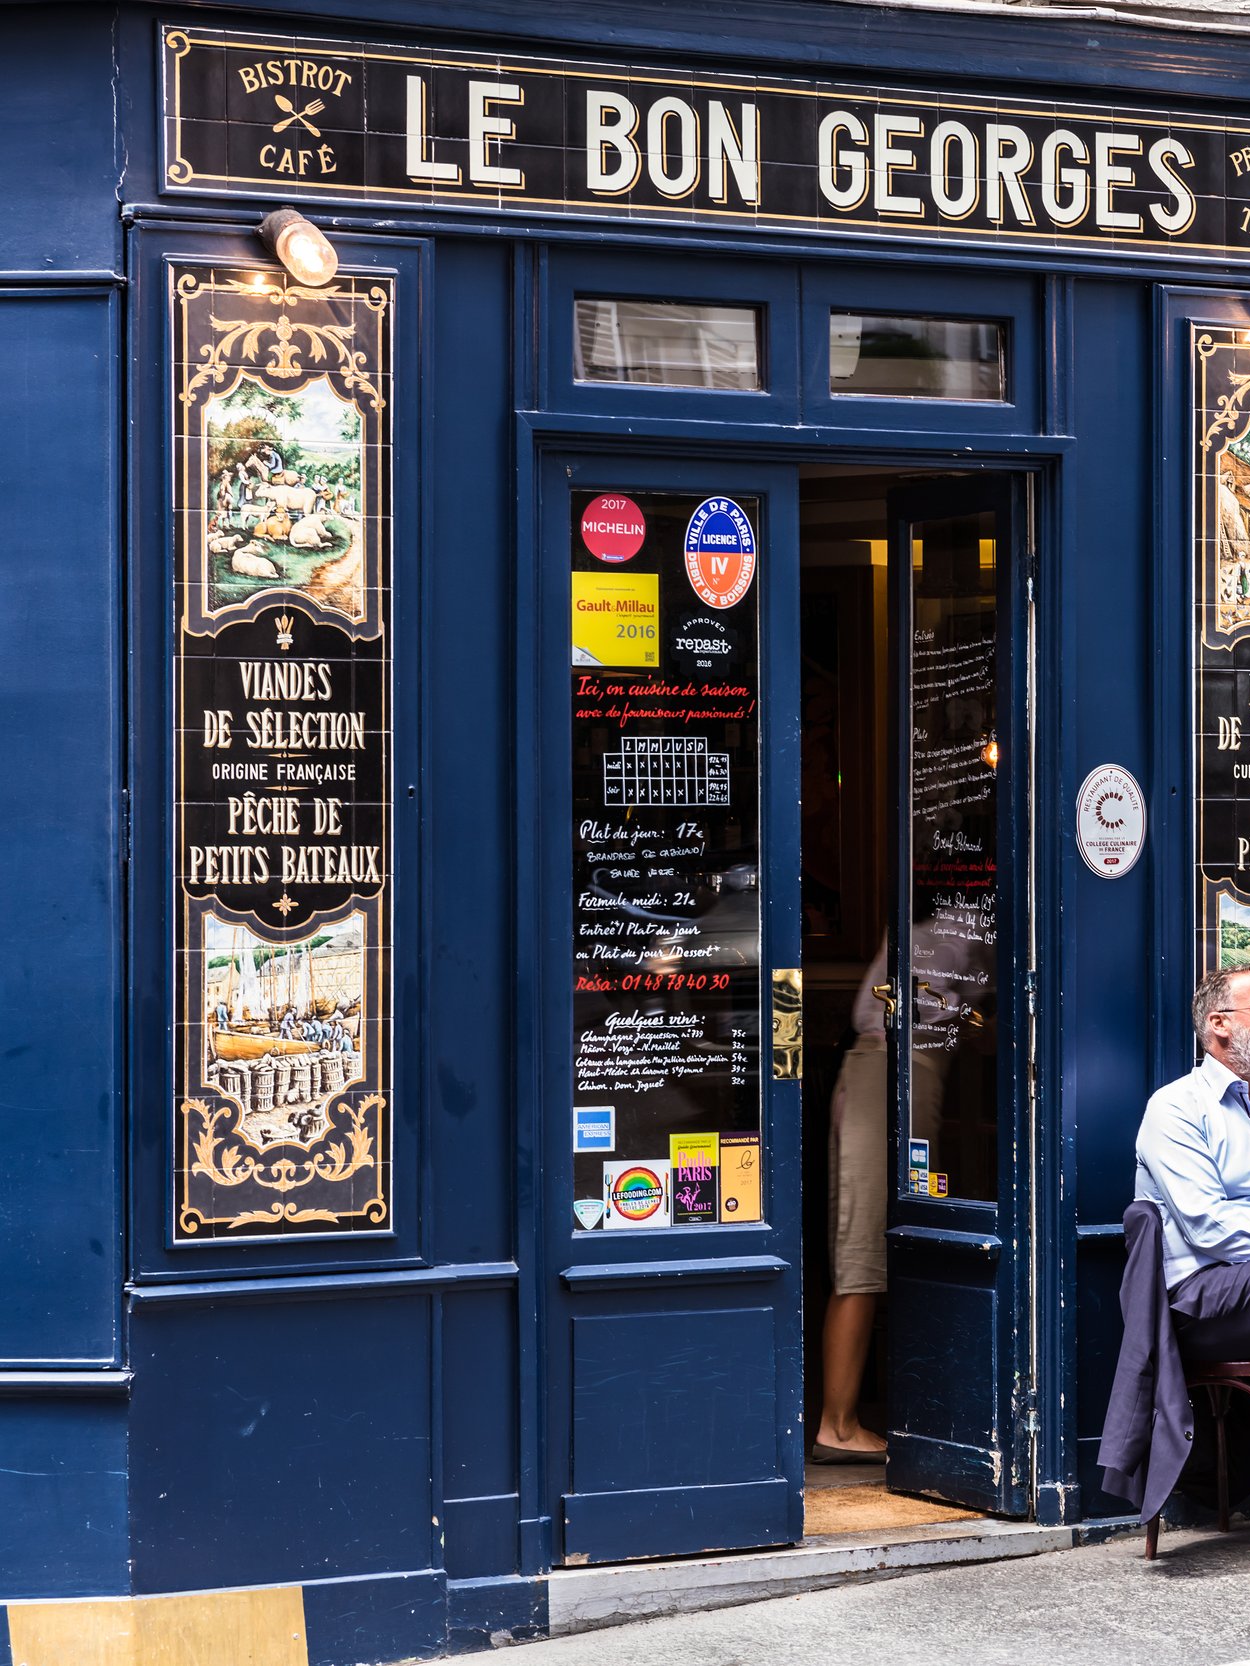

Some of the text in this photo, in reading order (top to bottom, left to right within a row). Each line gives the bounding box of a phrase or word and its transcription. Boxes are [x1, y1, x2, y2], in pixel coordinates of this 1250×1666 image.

[238, 60, 352, 98] BISTROT
[259, 143, 338, 177] CAFÉ
[406, 75, 1197, 236] LE BON GEORGES
[601, 499, 626, 510] 2017
[582, 521, 644, 536] MICHELIN
[688, 501, 751, 547] VILLE DE PARIS
[702, 534, 738, 545] LICENCE
[711, 557, 729, 575] IV
[688, 552, 753, 606] DEBIT DE BOISSONS
[616, 624, 656, 639] 2016
[682, 617, 725, 633] APPROVED
[696, 660, 712, 668] 2016
[239, 661, 333, 701] VIANDES
[576, 675, 750, 701] Ici, on cuisine de saison
[575, 706, 602, 718] avec
[605, 705, 621, 718] des
[203, 707, 366, 750] DE SÉLECTION
[1217, 716, 1242, 751] DE
[625, 741, 704, 752] L M M J V S D
[212, 763, 356, 785] ORIGINE FRANÇAISE
[1084, 775, 1112, 812] RESTAURANT
[1113, 776, 1123, 784] DE
[227, 790, 343, 836] PÊCHE DE
[579, 820, 611, 840] Plat
[612, 825, 628, 839] du
[188, 845, 382, 885] PETITS BATEAUX
[578, 893, 629, 908] Formule
[626, 923, 701, 939] Plat du jour
[592, 945, 621, 959] Plat
[621, 948, 636, 958] du
[635, 946, 668, 965] jour
[622, 974, 641, 990] 01
[644, 974, 663, 990] 48
[668, 974, 684, 990] 78
[687, 974, 706, 990] 40
[709, 974, 730, 990] 30
[605, 1010, 663, 1034] Quelques
[580, 1031, 633, 1046] Champagne
[678, 1166, 712, 1182] PARIS
[613, 1188, 662, 1200] LEFOODING.COM
[693, 1203, 712, 1212] 2017
